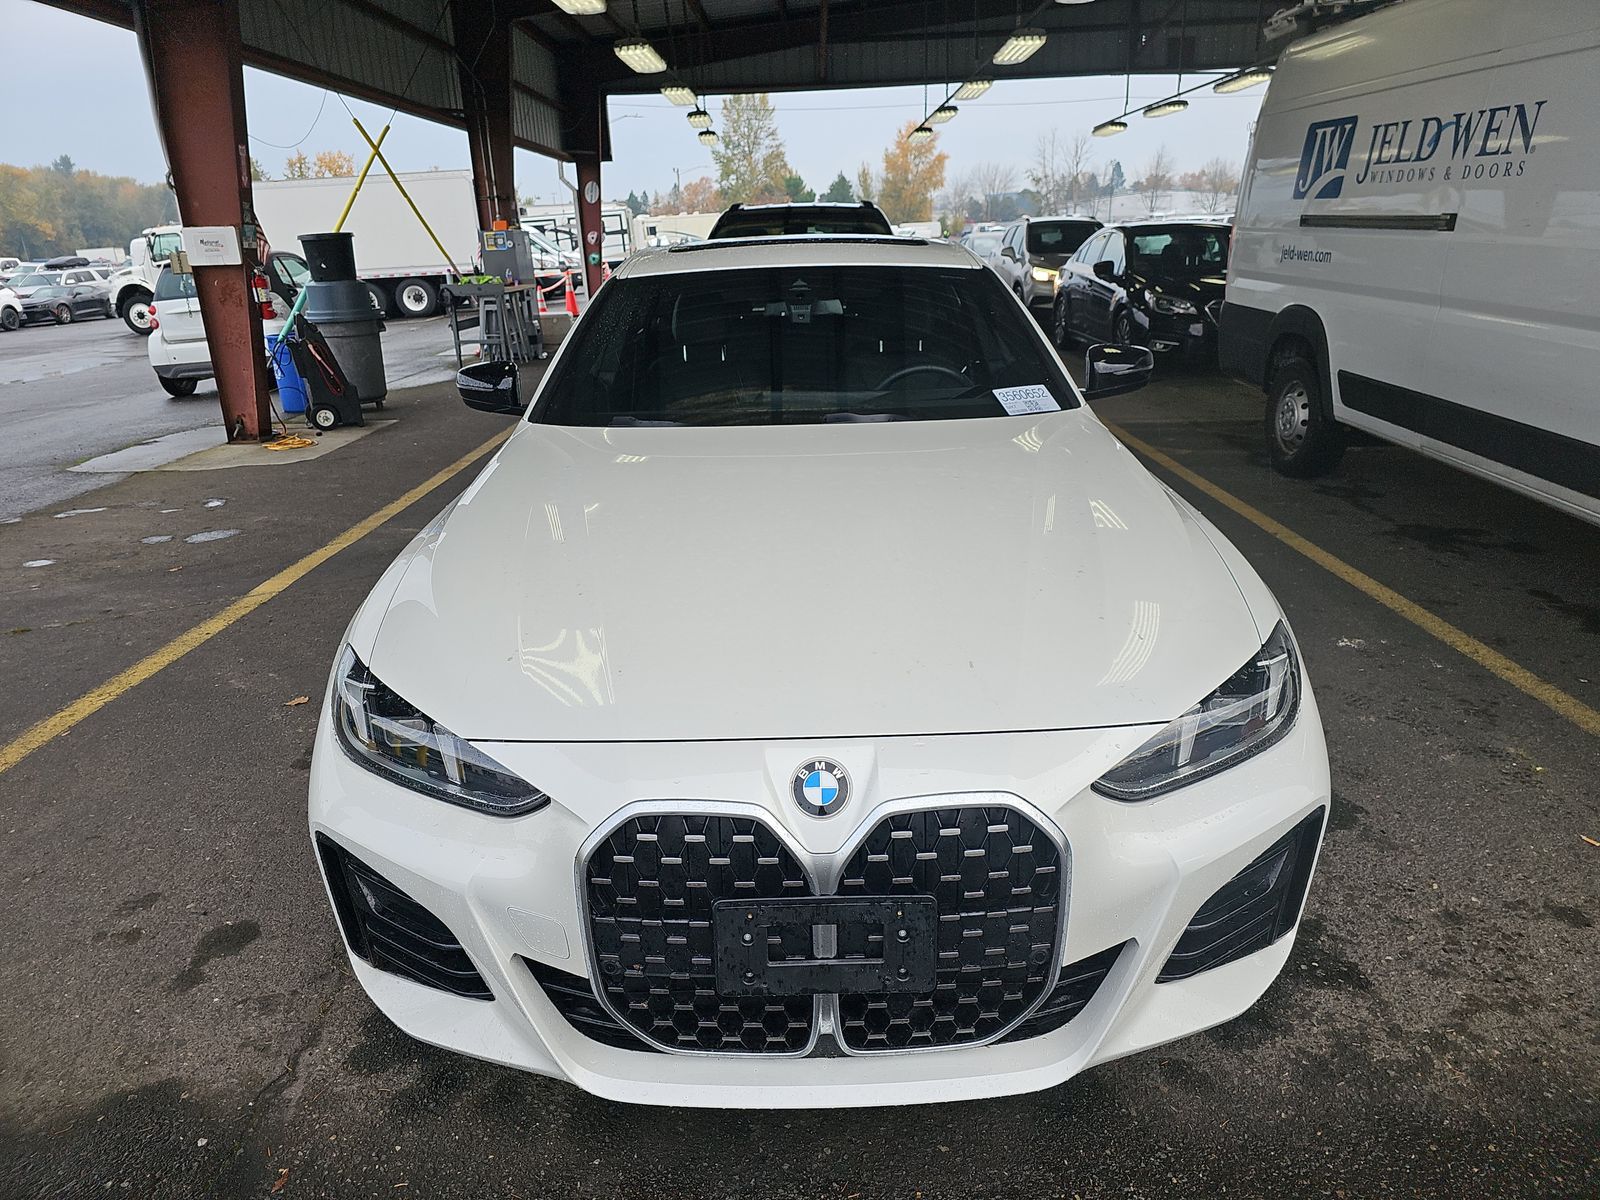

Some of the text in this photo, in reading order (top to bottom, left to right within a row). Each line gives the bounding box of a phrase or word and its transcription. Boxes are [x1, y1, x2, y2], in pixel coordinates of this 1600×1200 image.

[1370, 160, 1527, 184] WINDOWS & DOORS
[1280, 244, 1332, 264] jeld-wen.com
[998, 387, 1048, 403] 3560652
[797, 761, 844, 780] BMW
